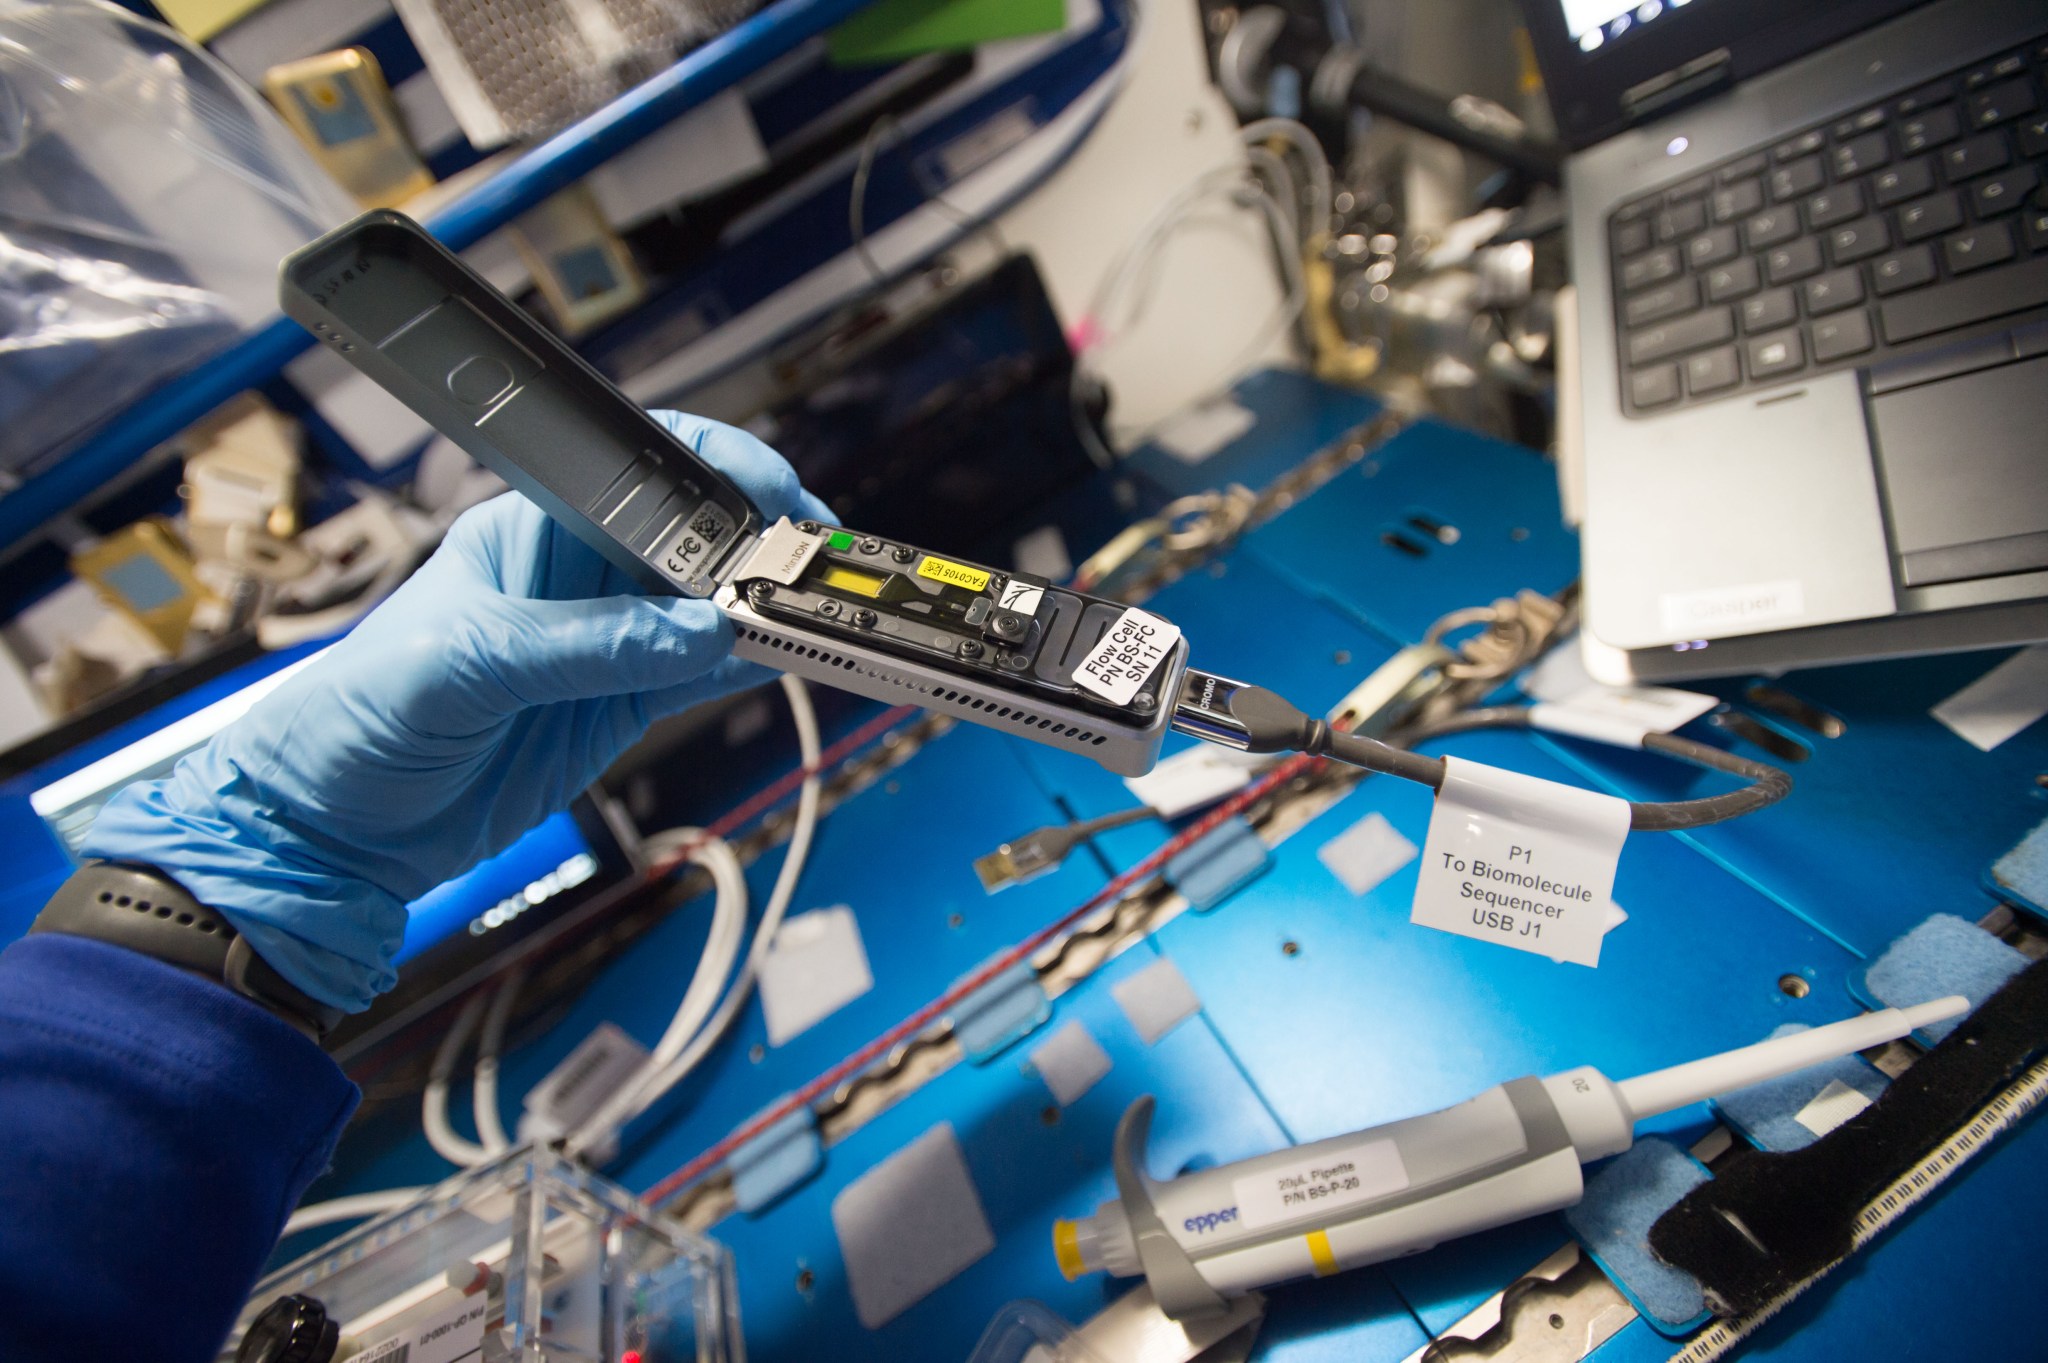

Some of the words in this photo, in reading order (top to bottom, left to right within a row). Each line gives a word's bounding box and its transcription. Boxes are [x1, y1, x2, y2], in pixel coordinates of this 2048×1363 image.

[782, 541, 810, 574] MinION
[943, 568, 986, 587] FAC0105
[1085, 644, 1118, 676] Flow
[1112, 618, 1139, 644] Cell
[1099, 664, 1123, 687] PN
[1116, 625, 1155, 665] BS-FC
[1126, 660, 1150, 682] SN
[1143, 645, 1162, 660] 11
[1200, 678, 1216, 711] CROMO
[1509, 845, 1532, 864] P1
[1443, 852, 1466, 872] To
[1472, 860, 1592, 902] Biomolecule
[1460, 881, 1565, 919] Sequencer
[1472, 908, 1514, 932] USB
[1520, 921, 1541, 938] J1
[1572, 1078, 1590, 1093] 20
[1310, 1162, 1355, 1182] Pipette
[1283, 1191, 1306, 1207] P/N
[1309, 1176, 1360, 1202] BS-P-20
